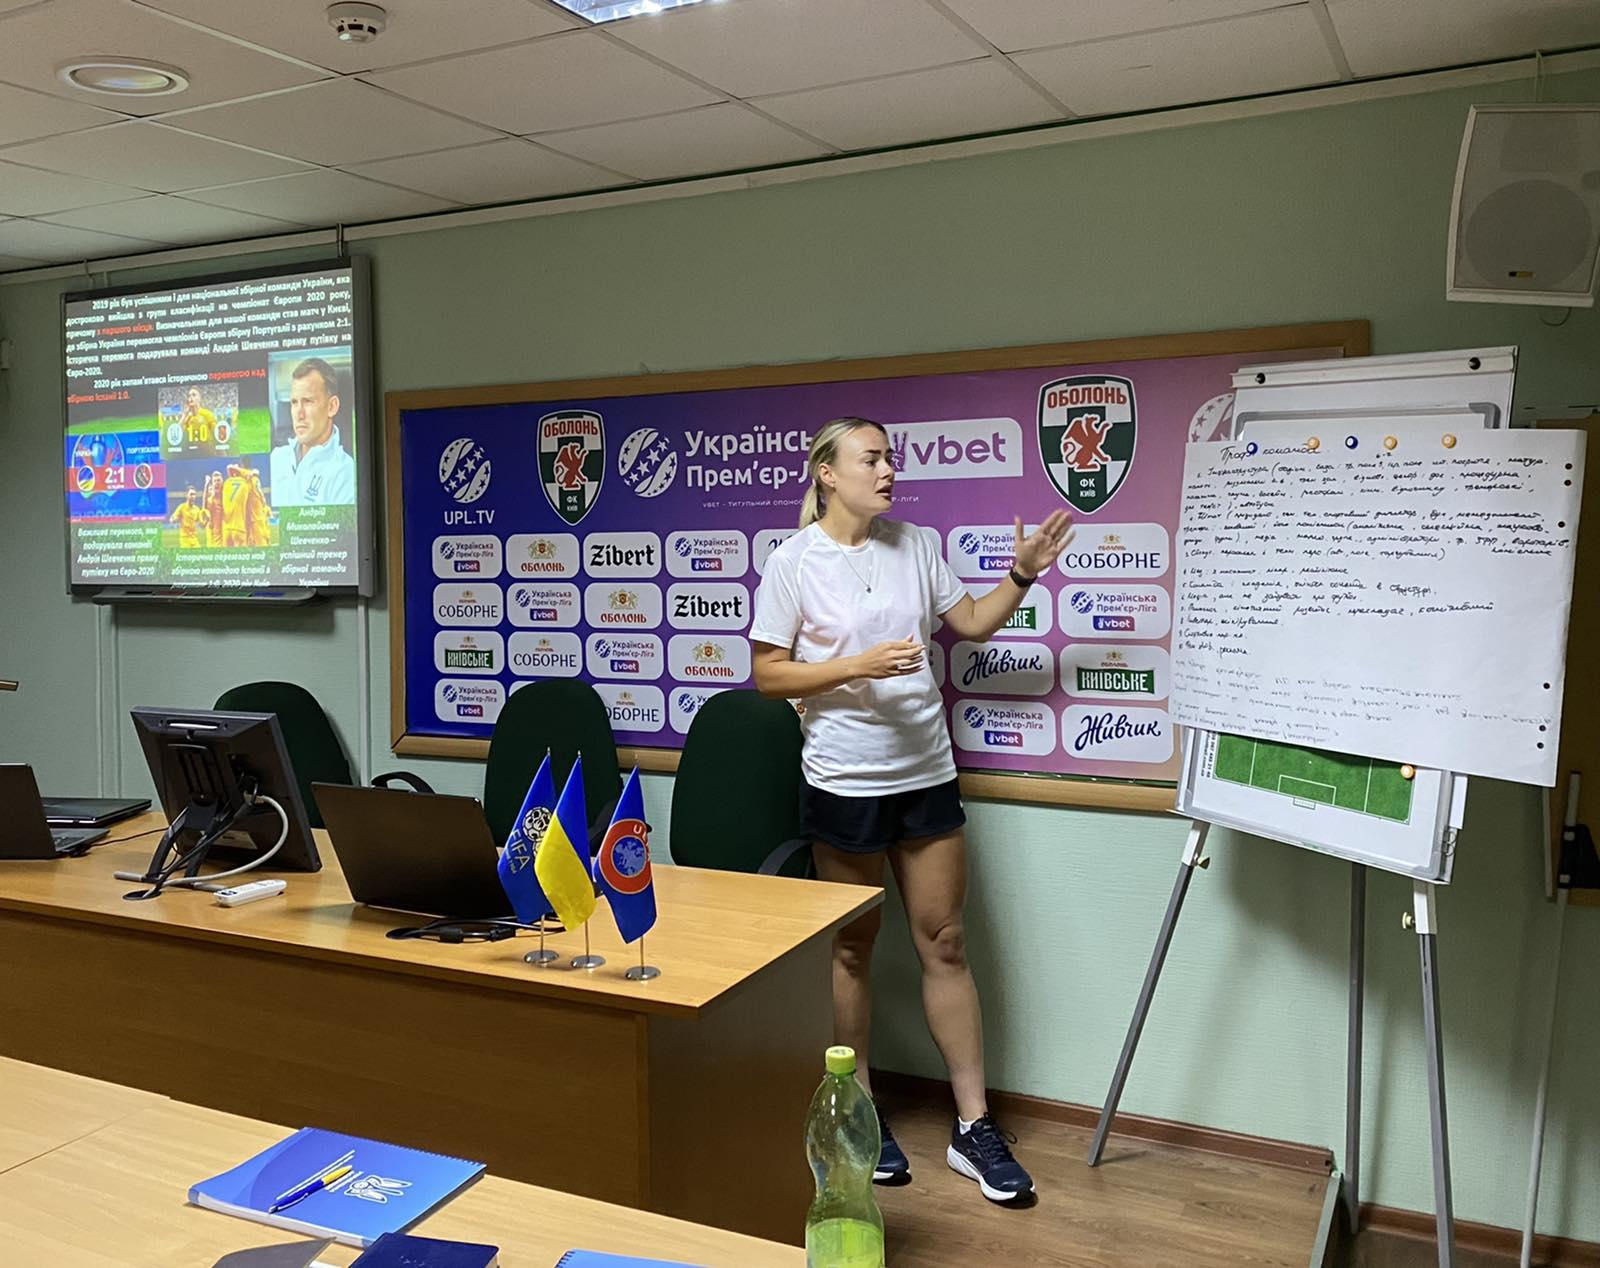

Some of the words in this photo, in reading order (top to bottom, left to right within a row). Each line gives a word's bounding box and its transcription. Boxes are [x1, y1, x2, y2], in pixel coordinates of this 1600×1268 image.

[307, 292, 326, 302] 2020
[93, 300, 109, 310] 2019
[1048, 387, 1127, 409] ОБОЛОНЬ
[188, 424, 208, 442] 1:0
[544, 421, 599, 438] ОБОЛОНЬ
[685, 425, 814, 461] Українсь
[911, 432, 1006, 465] vbet
[105, 468, 125, 484] 2:1
[687, 461, 809, 491] Прем'єр-Л
[1080, 479, 1095, 488] ФК
[444, 510, 495, 525] UPL.TV
[983, 533, 1016, 544] Україн
[590, 544, 654, 566] Zibert
[1066, 553, 1160, 569] СОБОРНЕ
[521, 563, 565, 572] ОБОЛОНЬ
[674, 595, 742, 618] Zibert
[1097, 593, 1157, 605] Українська
[439, 605, 498, 618] СОБОРНЕ
[601, 613, 647, 624] ОБОЛОНЬ
[1104, 619, 1131, 629] vbet
[514, 653, 577, 668] СОБОРНЕ
[962, 648, 1043, 686] Живчик
[685, 666, 734, 677] ОБОЛОНЬ
[606, 707, 660, 722] ОБОРНЕ
[987, 709, 1043, 721] Українська
[994, 734, 1019, 745] vbet
[1075, 713, 1161, 751] Живчик
[510, 829, 530, 871] FIFA
